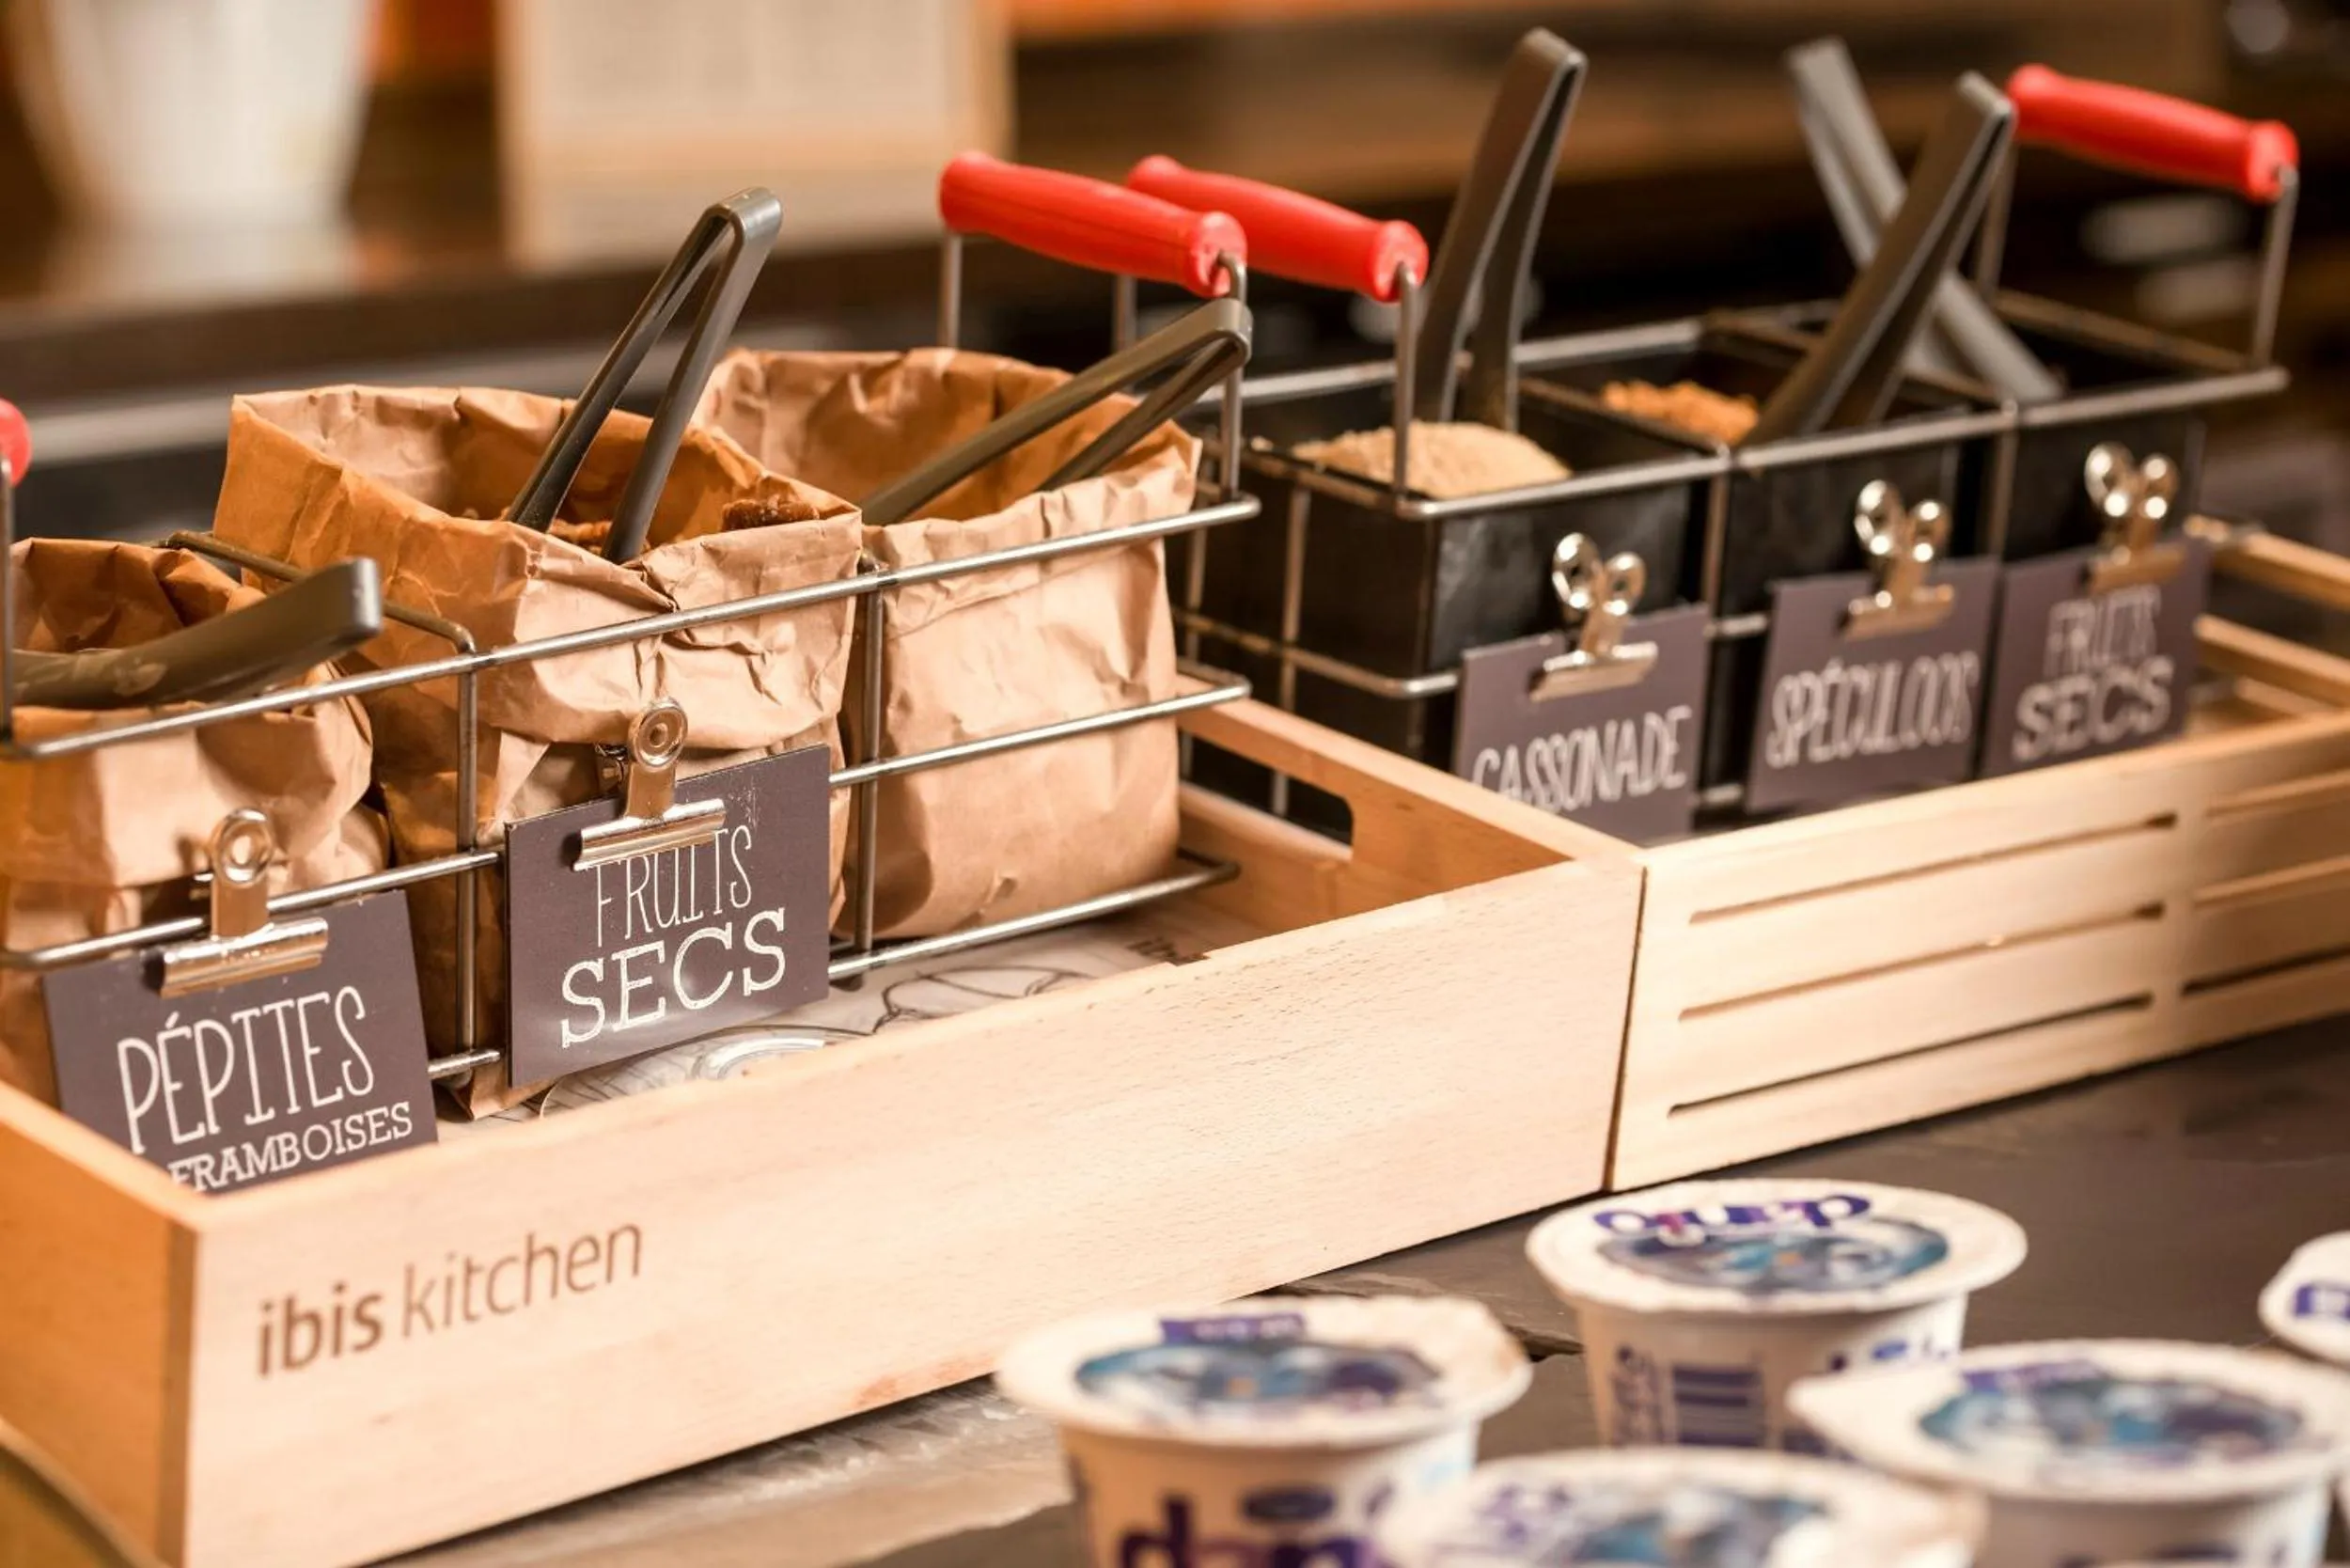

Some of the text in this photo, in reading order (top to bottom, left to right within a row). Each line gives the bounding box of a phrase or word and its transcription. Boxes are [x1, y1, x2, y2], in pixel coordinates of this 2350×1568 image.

[2011, 655, 2173, 762] SECS
[588, 824, 752, 948] FRUITS
[561, 907, 786, 1048] SECS
[117, 985, 374, 1155] PÉPITES
[167, 1101, 413, 1193] FRAMBOISES
[257, 1223, 642, 1379] ibis kitchen
